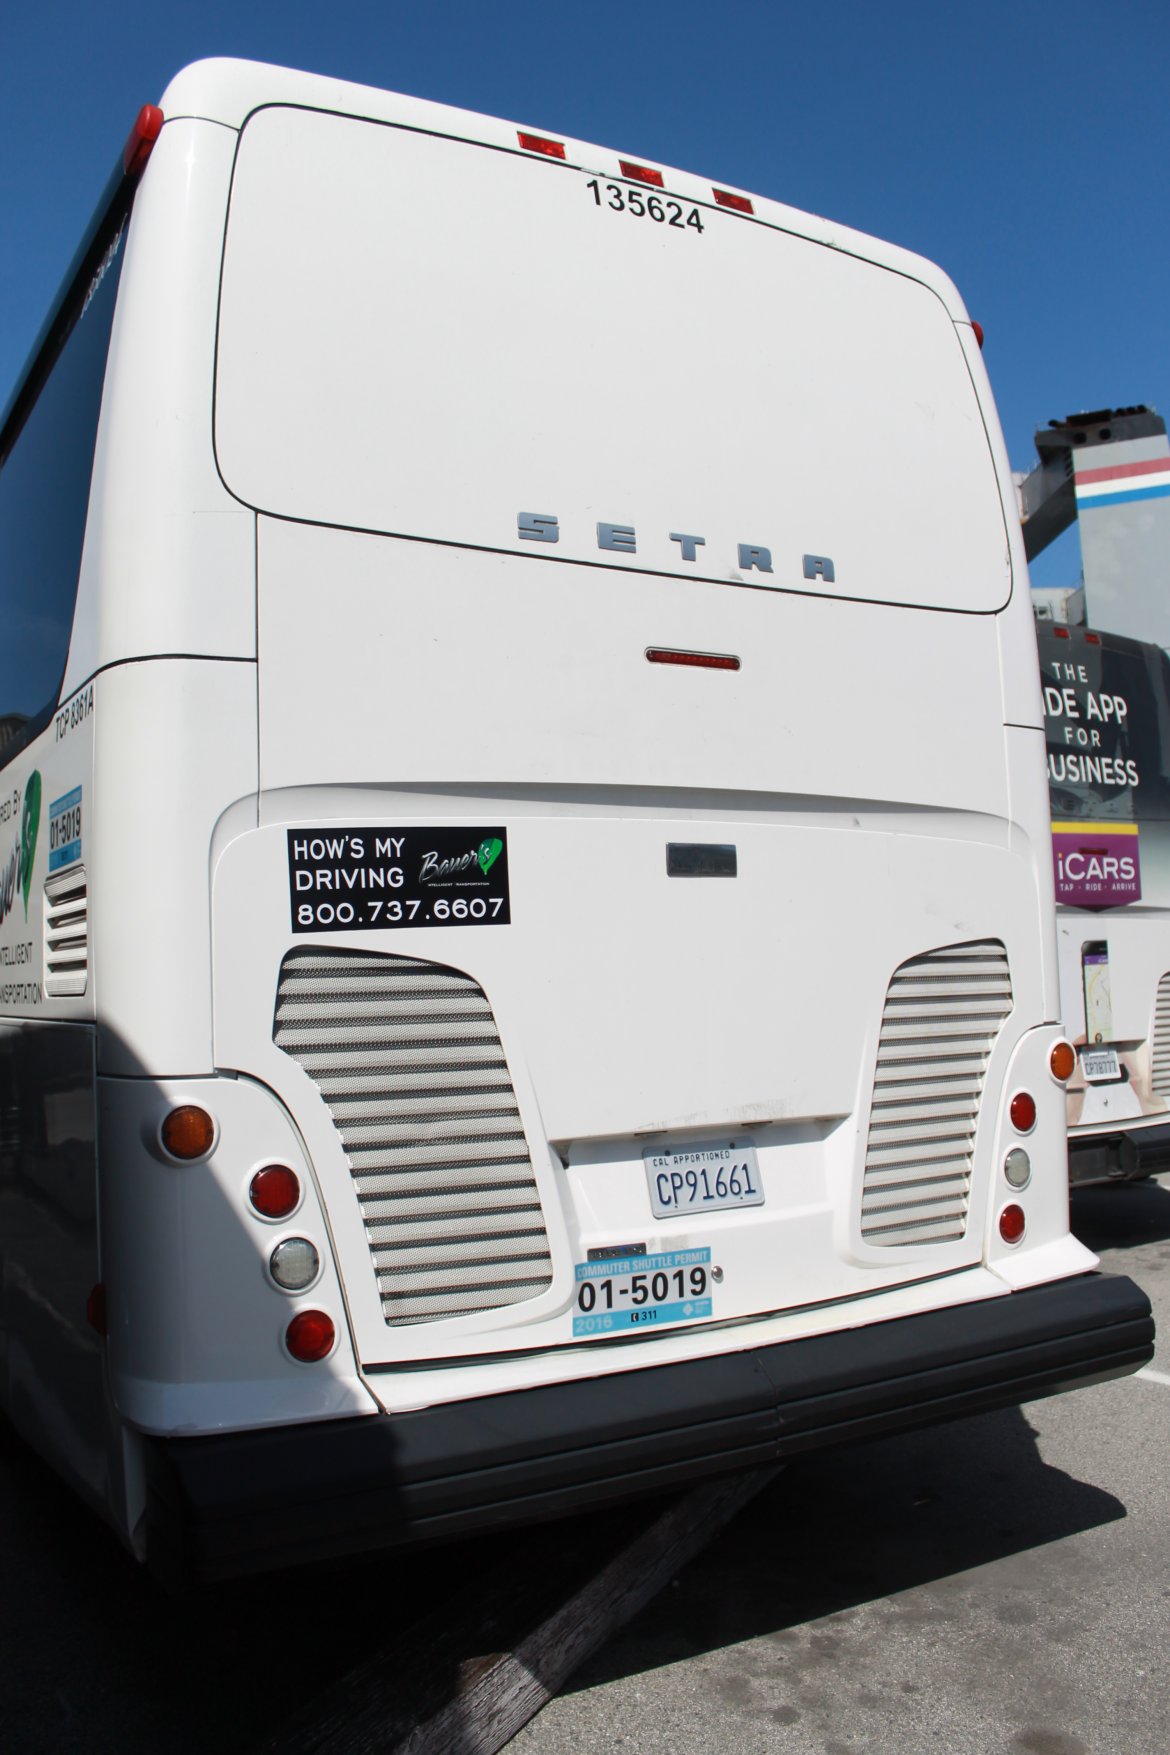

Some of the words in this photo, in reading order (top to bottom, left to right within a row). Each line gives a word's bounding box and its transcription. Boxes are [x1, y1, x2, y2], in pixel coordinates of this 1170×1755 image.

[587, 179, 705, 233] 135624
[517, 512, 835, 583] SETRA
[1051, 661, 1088, 683] THE
[55, 708, 70, 743] TCP
[71, 685, 94, 730] 8361A
[1087, 691, 1127, 724] APP
[1064, 727, 1101, 747] FOR
[1047, 754, 1139, 786] USINESS
[50, 806, 81, 849] 01-5019
[294, 835, 364, 860] HOW'S
[376, 838, 406, 858] MY
[418, 843, 492, 884] Bauer's
[1058, 852, 1135, 880] iCARS
[295, 868, 405, 891] DRIVING
[1060, 883, 1074, 891] TAP
[1085, 883, 1102, 891] RIDE
[297, 898, 504, 925] 800.737.6607
[653, 1158, 670, 1168] CAL
[674, 1150, 731, 1165] APPORTIONED
[656, 1163, 756, 1206] CP91661
[577, 1262, 630, 1279] COMMUTER
[633, 1255, 672, 1272] SHUTTLE
[675, 1250, 708, 1264] PERMIT
[578, 1267, 707, 1312] 01-5019
[641, 1310, 657, 1322] 311
